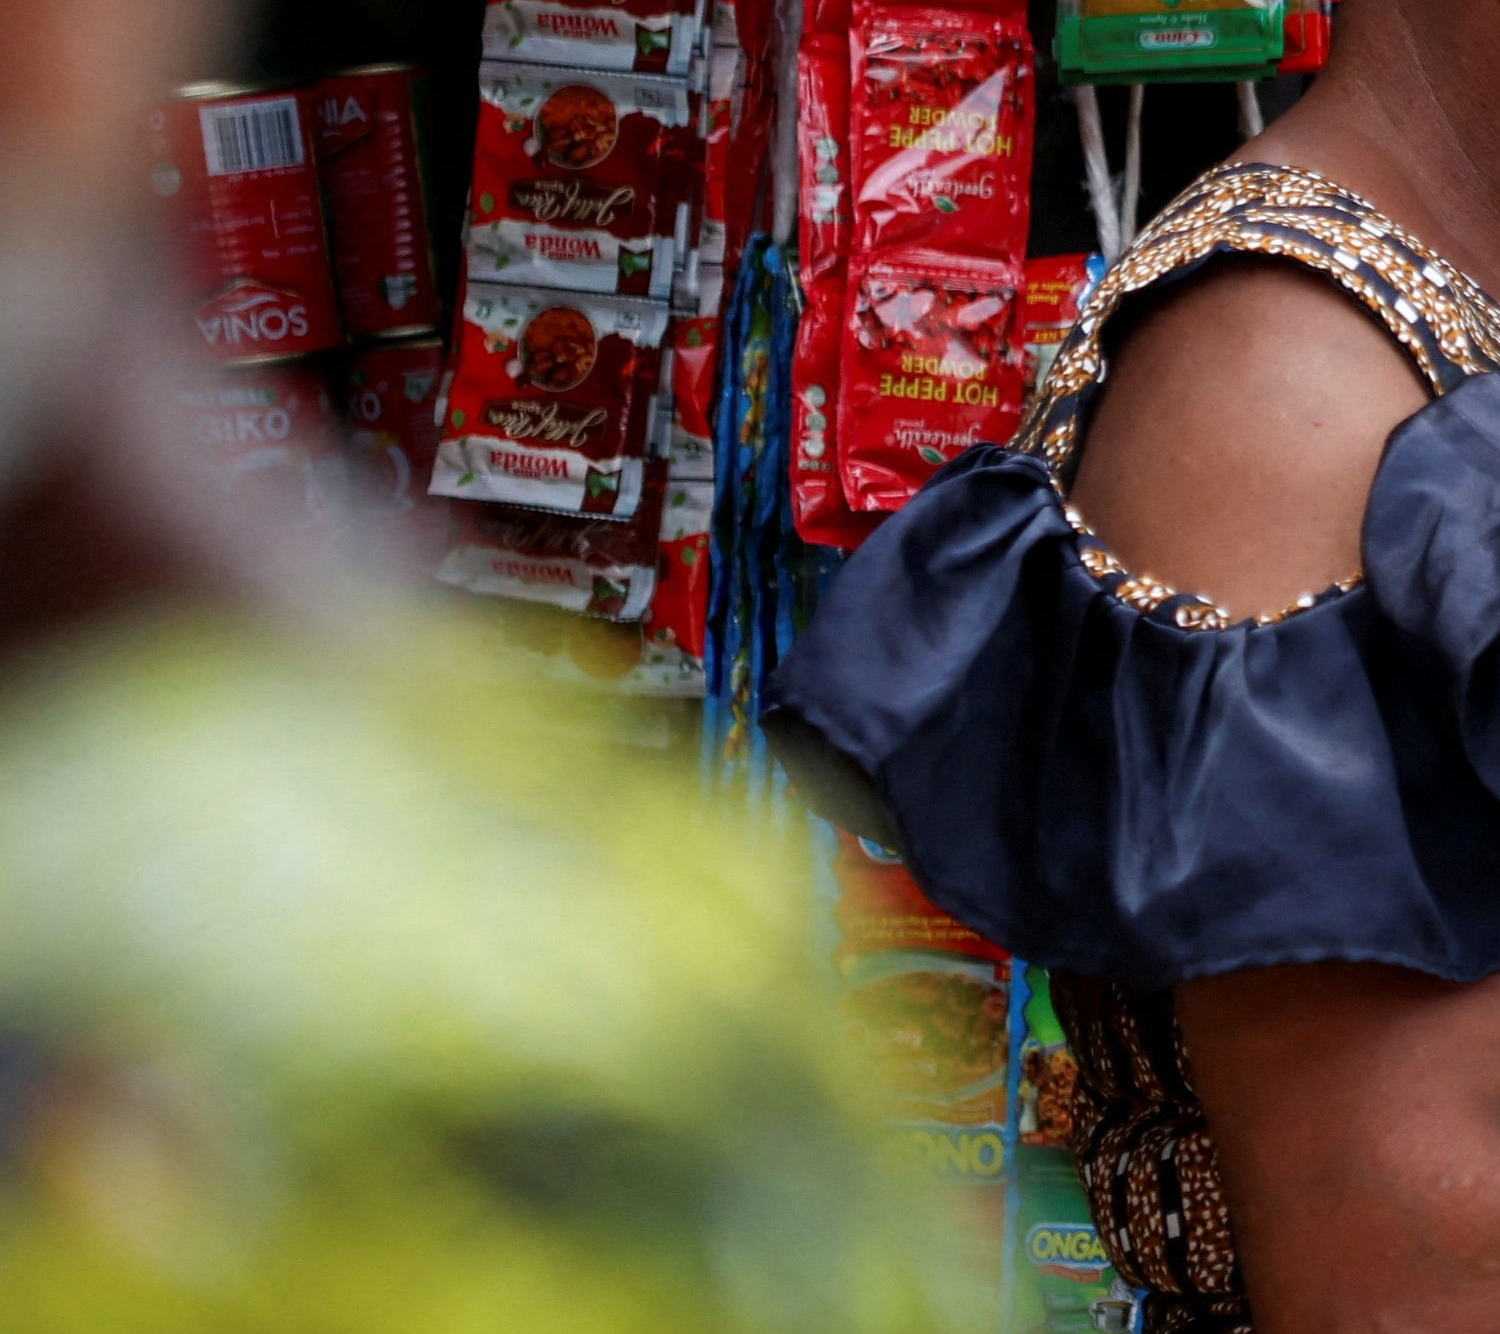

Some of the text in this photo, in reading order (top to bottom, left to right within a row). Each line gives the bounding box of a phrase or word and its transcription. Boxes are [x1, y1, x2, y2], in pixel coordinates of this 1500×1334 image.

[536, 12, 620, 40] Wonda
[908, 105, 996, 131] POWDER
[963, 131, 1012, 158] HOT
[524, 233, 603, 262] Wonda
[195, 304, 311, 347] SONIA
[900, 354, 988, 381] POWDER
[951, 381, 999, 408] HOT
[490, 451, 570, 481] Wonda
[1031, 1230, 1108, 1261] ONGA
